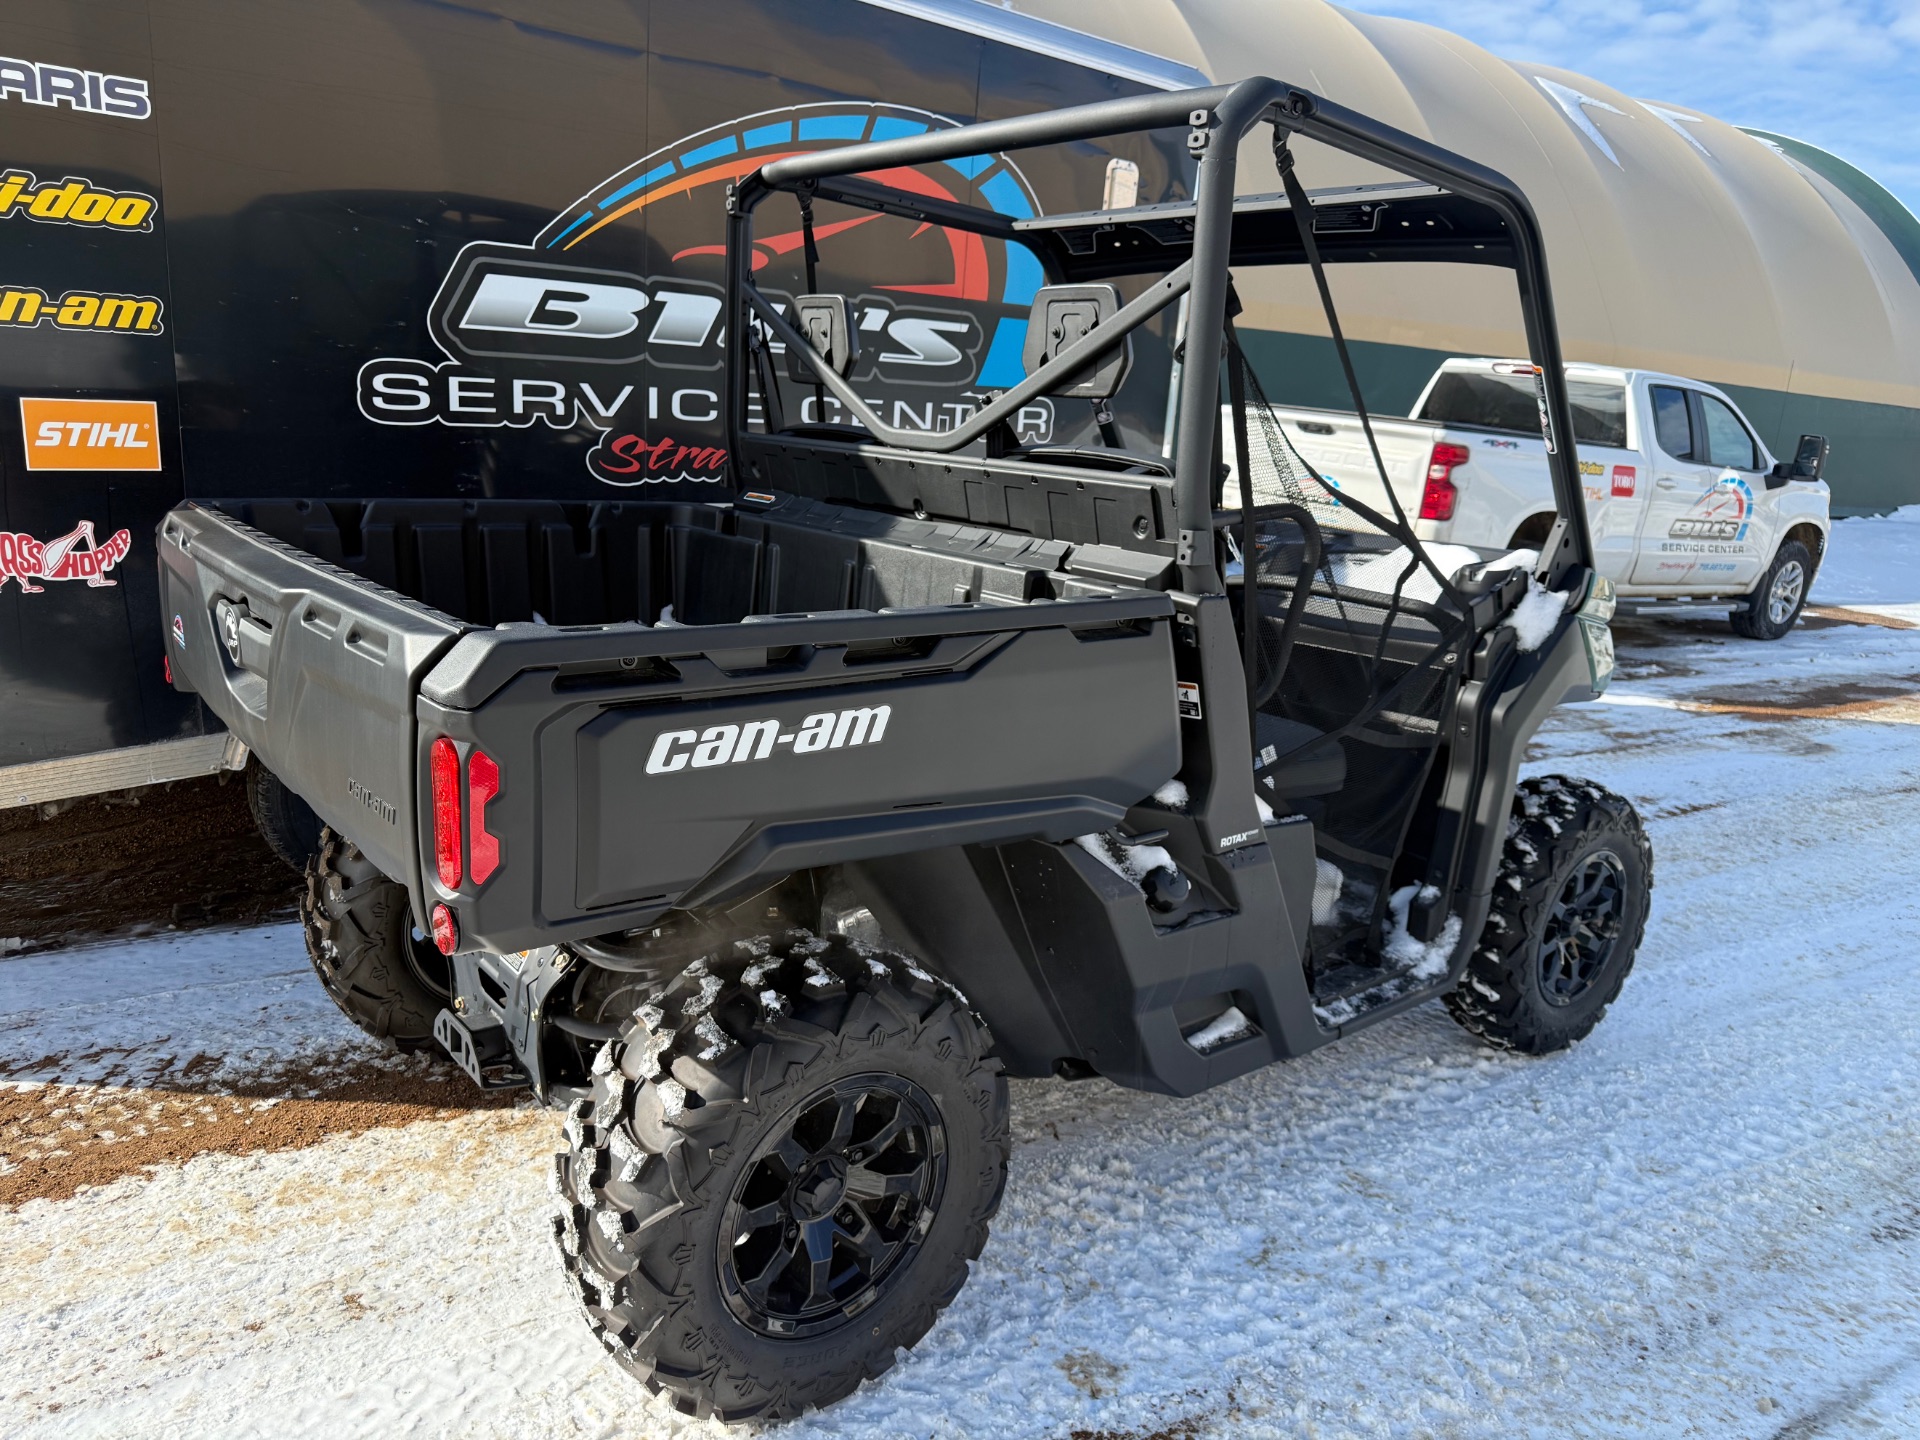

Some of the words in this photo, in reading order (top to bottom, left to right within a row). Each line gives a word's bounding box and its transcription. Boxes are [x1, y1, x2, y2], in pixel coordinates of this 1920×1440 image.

[0, 175, 151, 226] i-doo
[0, 291, 158, 330] n-am
[459, 273, 969, 366] BI'S
[801, 396, 1049, 434] CNTR
[35, 421, 149, 448] STIHL
[1613, 475, 1635, 488] TORO
[0, 529, 129, 578] ASSHOPPER
[1661, 543, 1705, 553] SERVICE
[1708, 544, 1744, 554] CENTER
[645, 705, 892, 775] can-am
[1220, 831, 1248, 848] ROTAX
